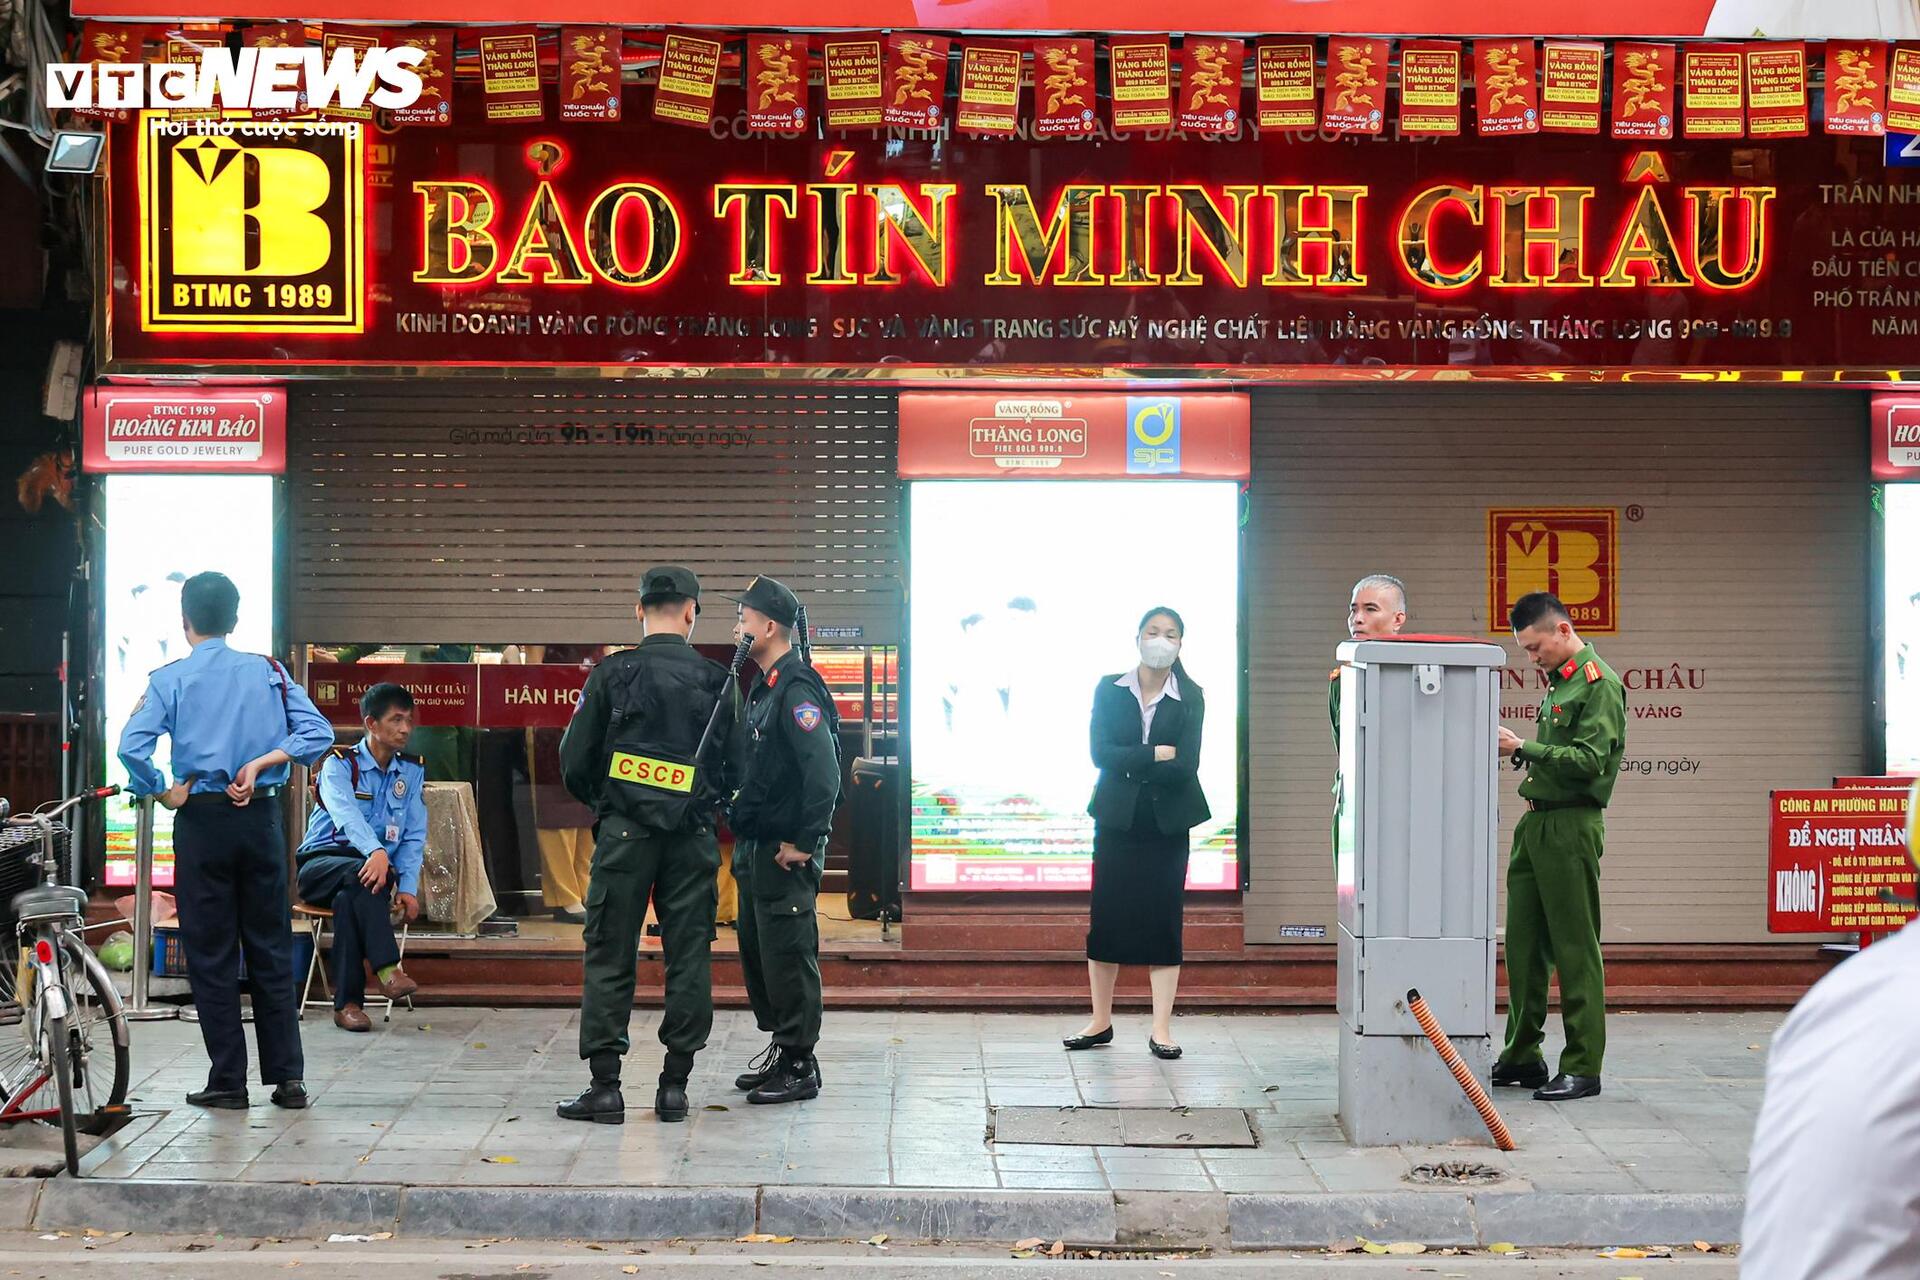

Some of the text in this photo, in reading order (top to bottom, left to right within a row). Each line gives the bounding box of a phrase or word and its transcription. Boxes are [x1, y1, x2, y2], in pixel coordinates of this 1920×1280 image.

[413, 141, 1776, 288] BẢO TÍN MINH CHÂU
[1859, 257, 1899, 277] TIÊN
[173, 284, 333, 309] BTMC 1989
[396, 313, 447, 333] KINH
[452, 313, 530, 334] DOANH
[538, 310, 599, 334] VÀNG
[832, 318, 871, 338] SJC
[981, 318, 1053, 339] TRANG
[1059, 314, 1101, 339] SỨC
[1108, 315, 1139, 339] MỸ
[1148, 315, 1207, 344] NGHỆ
[1214, 313, 1270, 340] CHẤT
[1398, 313, 1456, 340] VÀNG
[1462, 312, 1523, 340] RỒNG
[1529, 315, 1604, 340] THĂNG
[1612, 319, 1672, 340] LONG
[153, 406, 216, 415] BTMC 1989
[112, 414, 256, 437] HOÀNG KIM BẢO
[973, 425, 1083, 443] THĂNG LONG
[124, 446, 243, 455] PURE GOLD JEWELRY
[1623, 663, 1705, 690] CHÂU
[505, 685, 547, 704] HÂN
[1635, 703, 1682, 718] VÀNG
[618, 758, 685, 784] CSCĐ
[1657, 757, 1700, 774] ngày
[1780, 797, 1810, 812] CÔNG
[1814, 800, 1828, 812] AN
[1832, 797, 1876, 812] PHƯỜNG
[1880, 799, 1897, 811] HAI
[1789, 820, 1906, 851] ĐỀ NGHỊ NHÂN
[1776, 863, 1816, 912] KHÔNG
